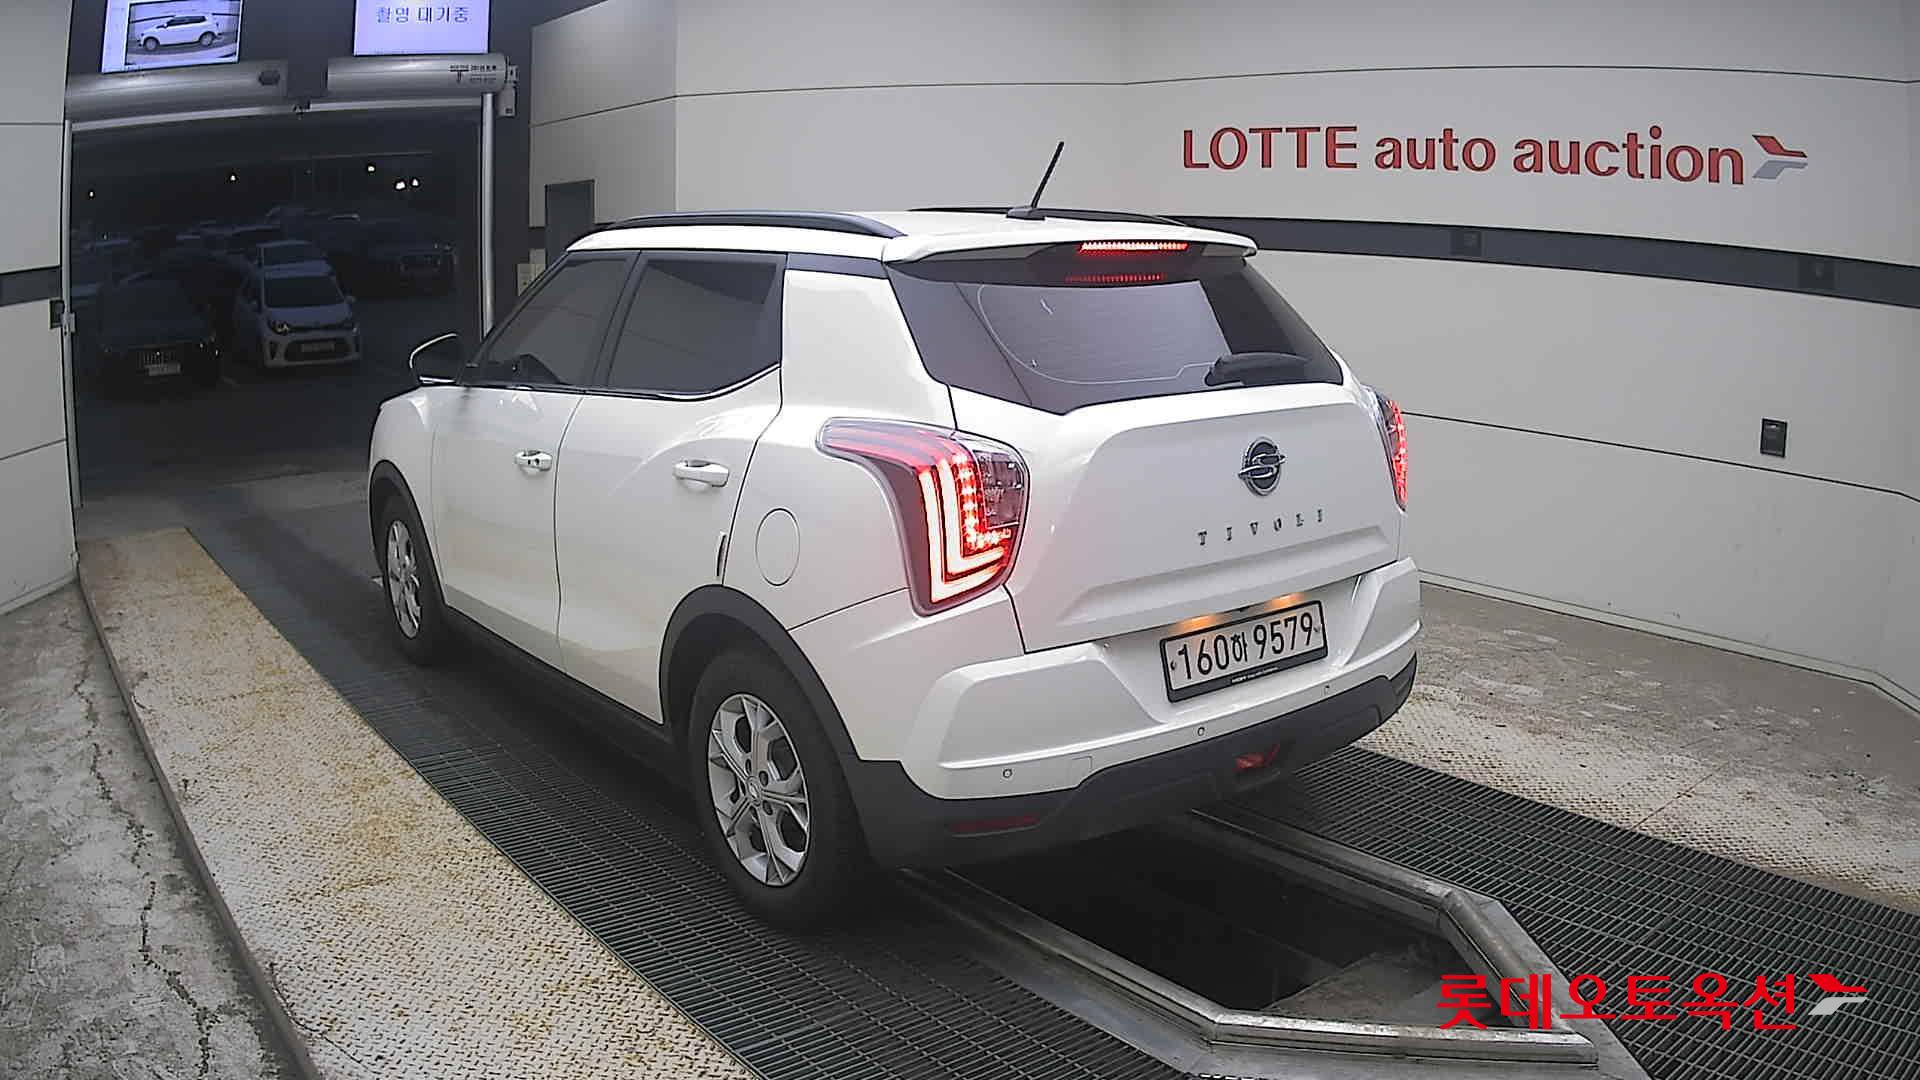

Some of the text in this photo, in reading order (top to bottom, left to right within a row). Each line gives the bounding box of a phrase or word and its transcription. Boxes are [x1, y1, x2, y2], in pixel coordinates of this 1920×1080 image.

[417, 6, 469, 23] 대기중
[1183, 126, 1745, 185] LOTTE auto auction
[1197, 508, 1325, 546] TIVOLI
[1177, 611, 1313, 680] 160하 9579
